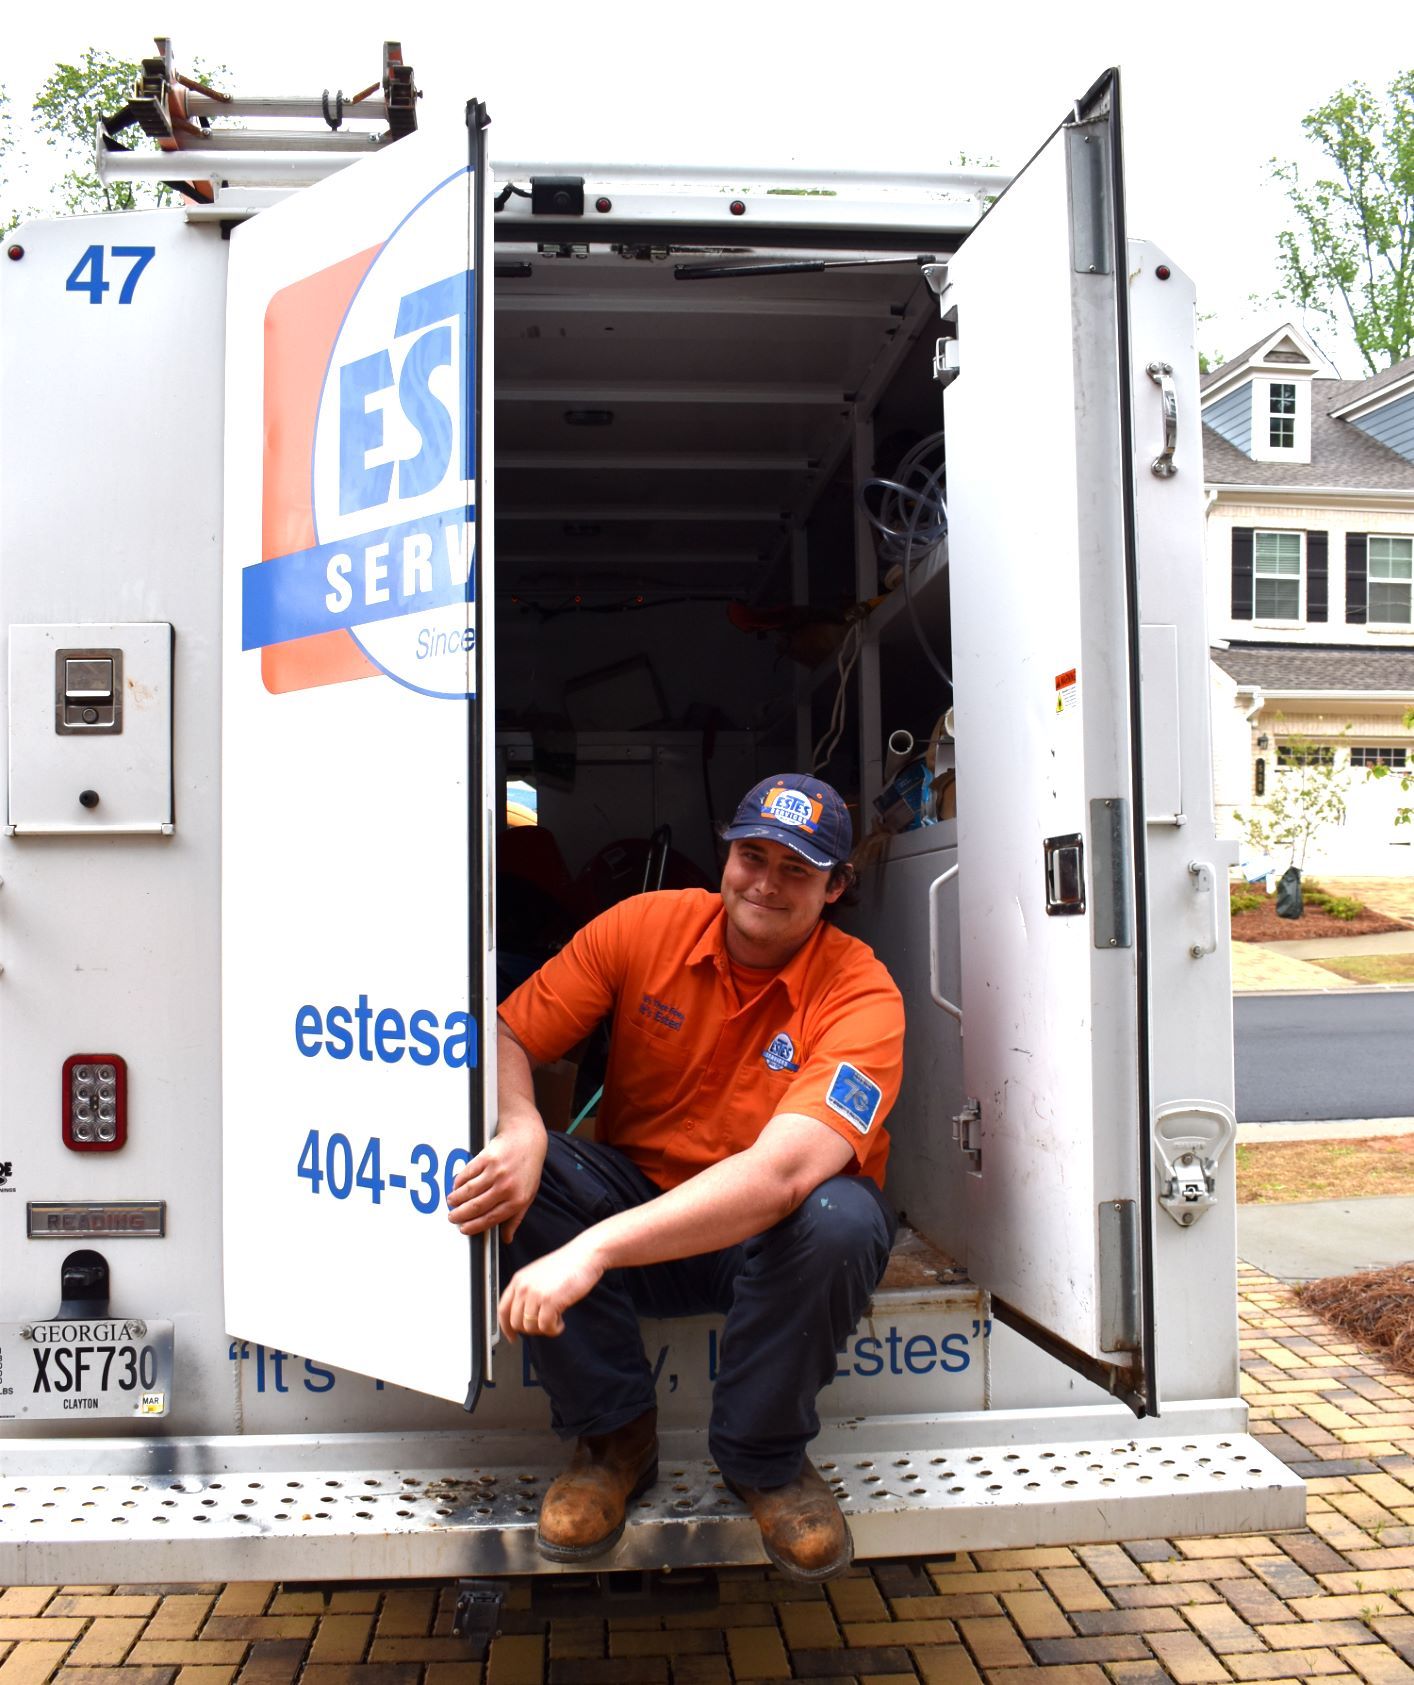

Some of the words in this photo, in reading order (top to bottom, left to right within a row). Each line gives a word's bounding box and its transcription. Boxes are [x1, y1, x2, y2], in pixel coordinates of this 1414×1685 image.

[65, 244, 156, 305] 47
[415, 627, 476, 660] Since
[776, 795, 810, 816] ESTES
[295, 994, 478, 1069] estesa
[769, 1038, 792, 1058] ESTES
[47, 1214, 146, 1231] READING
[32, 1323, 134, 1343] GEORGIA
[32, 1345, 158, 1393] XSF730
[63, 1398, 99, 1410] CLAYTON
[142, 1396, 160, 1405] MAR
